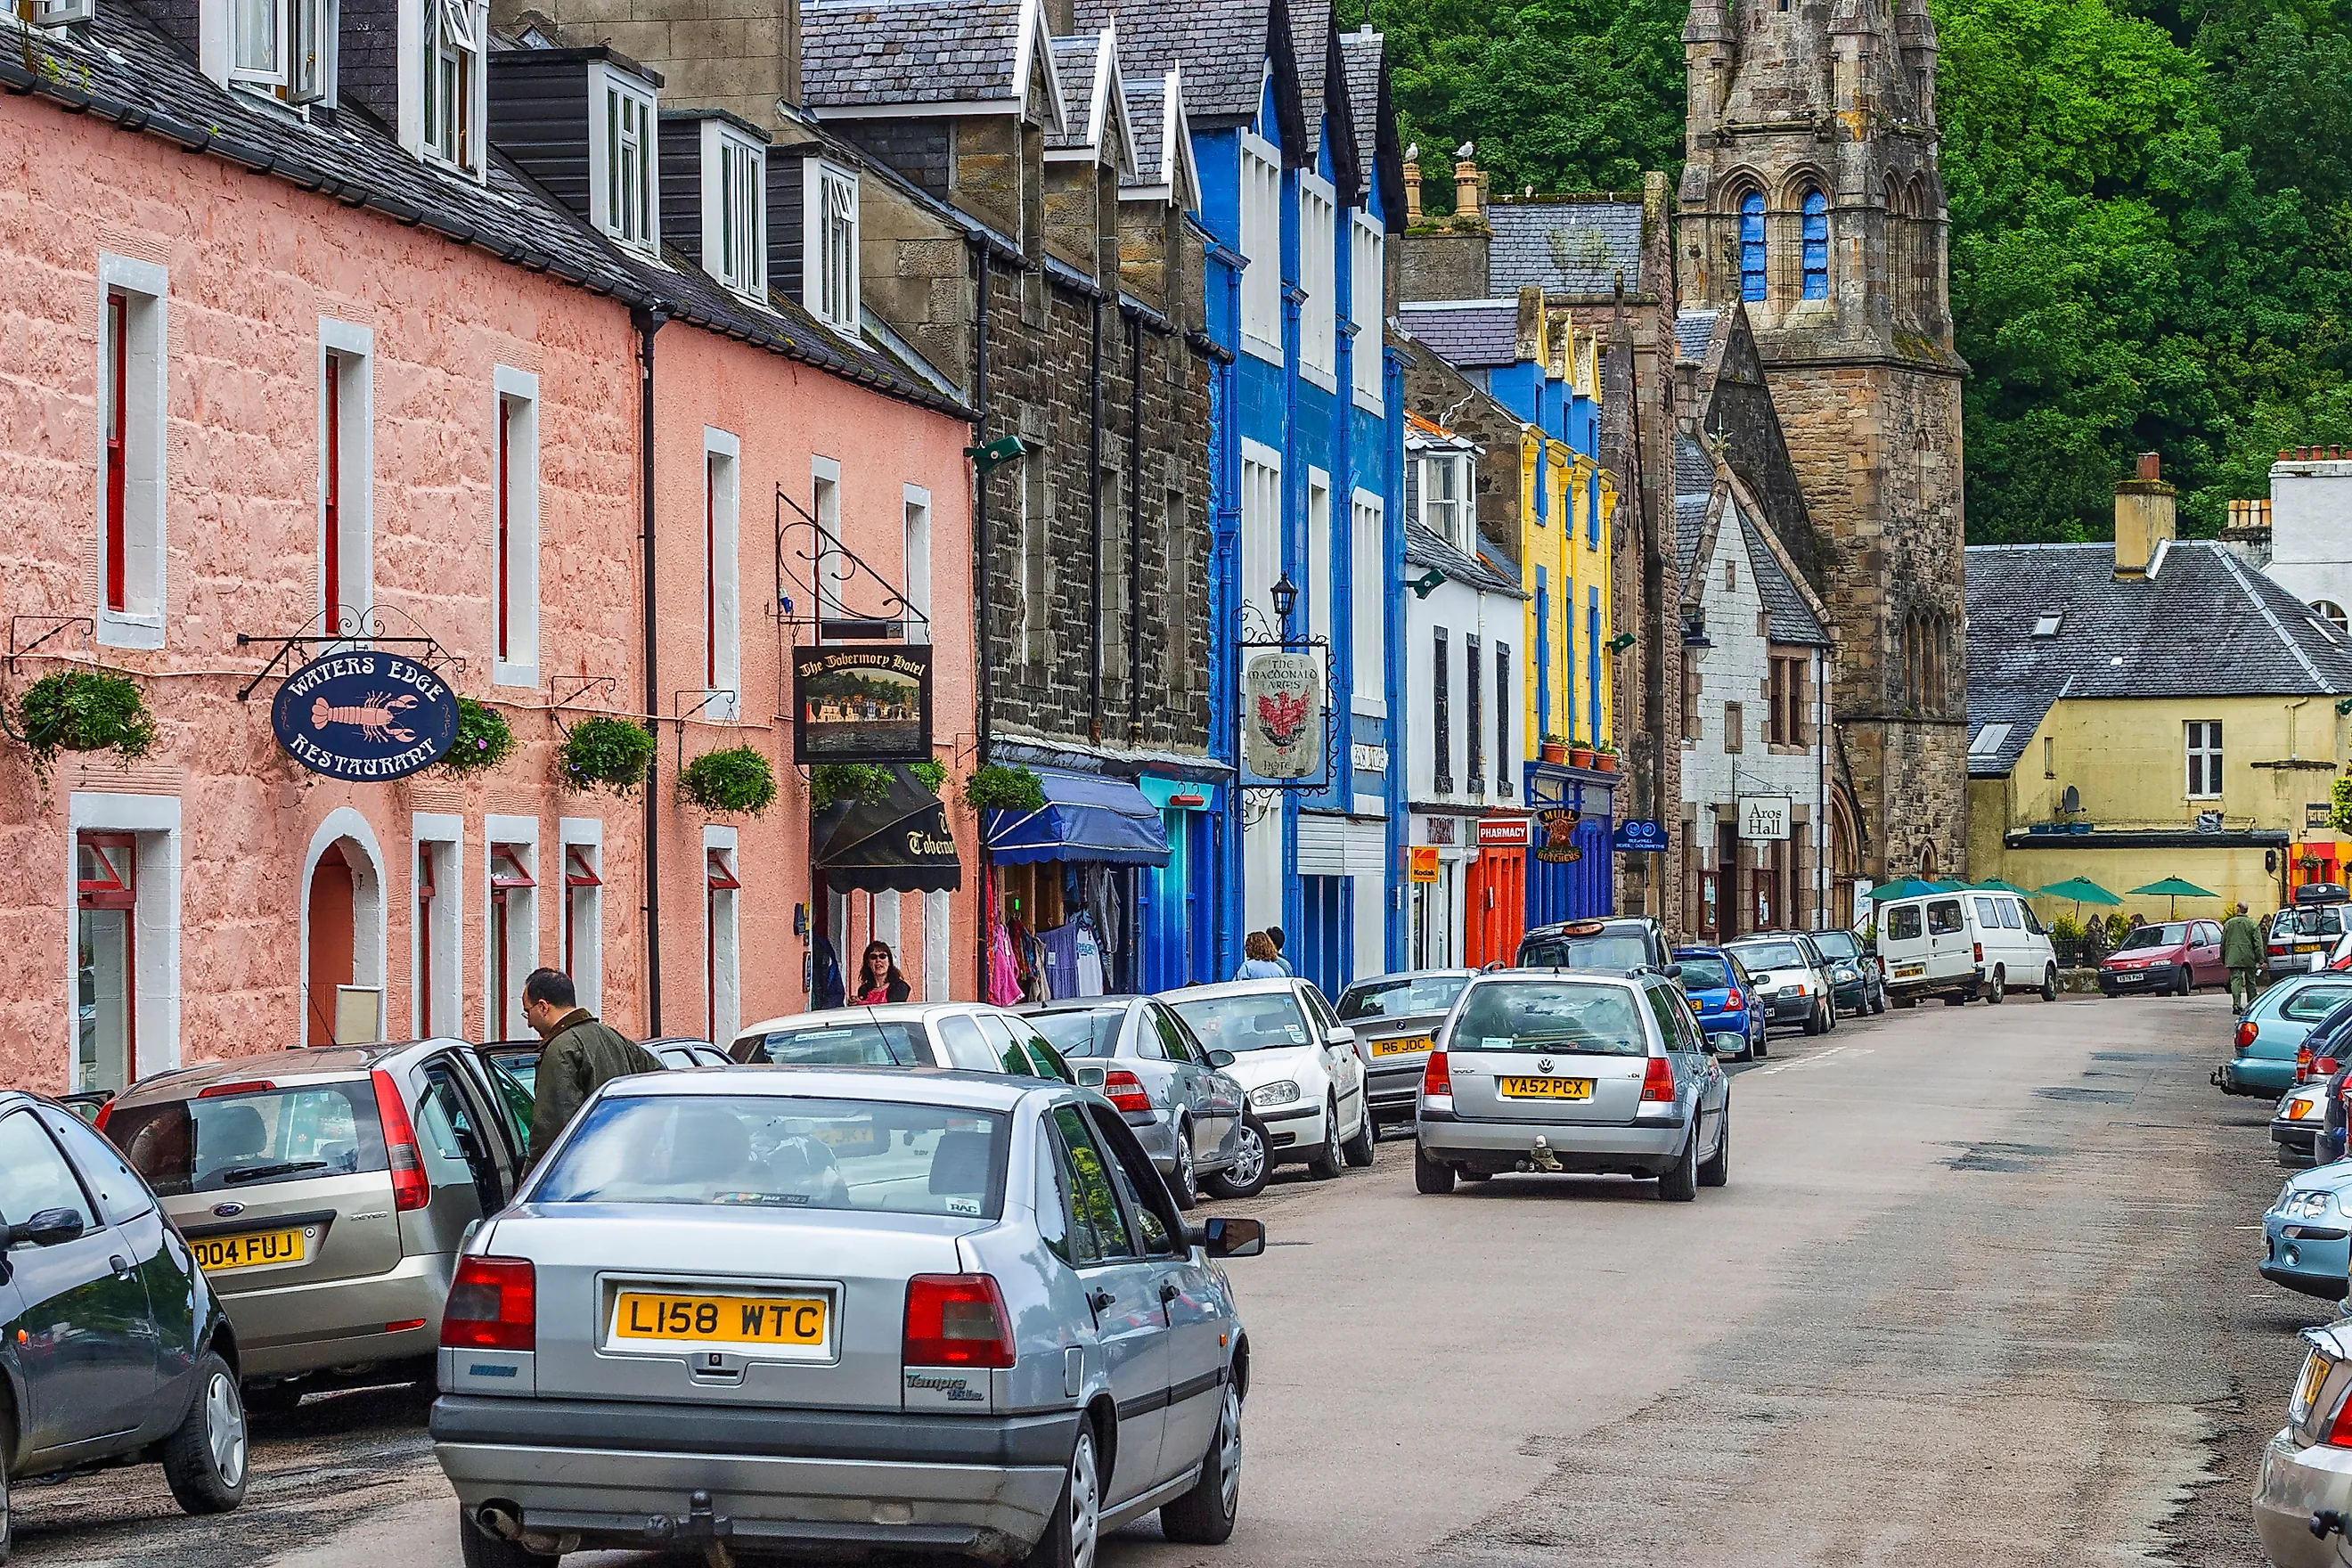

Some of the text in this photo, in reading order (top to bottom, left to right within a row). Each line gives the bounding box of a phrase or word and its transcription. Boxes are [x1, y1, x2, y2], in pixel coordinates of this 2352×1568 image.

[799, 652, 927, 677] The Tobermory Hotel
[1272, 660, 1294, 669] THE
[288, 657, 445, 703] WATERS EDGE
[1249, 669, 1318, 680] MACDONALD
[290, 732, 437, 775] RESTAURANT
[1544, 810, 1574, 821] MULL
[1748, 803, 1782, 819] Aros
[1480, 827, 1526, 838] PHARMACY
[1748, 820, 1781, 835] Hall
[1538, 851, 1580, 862] BUTCHERS
[1414, 869, 1435, 877] Kodak
[1382, 1038, 1425, 1053] R6 JDC
[1508, 1078, 1584, 1095] YA52 PCX
[951, 1204, 977, 1213] RAC
[246, 1233, 293, 1261] FUJ
[630, 1301, 818, 1338] L158 WTC
[906, 1373, 967, 1392] Tempra
